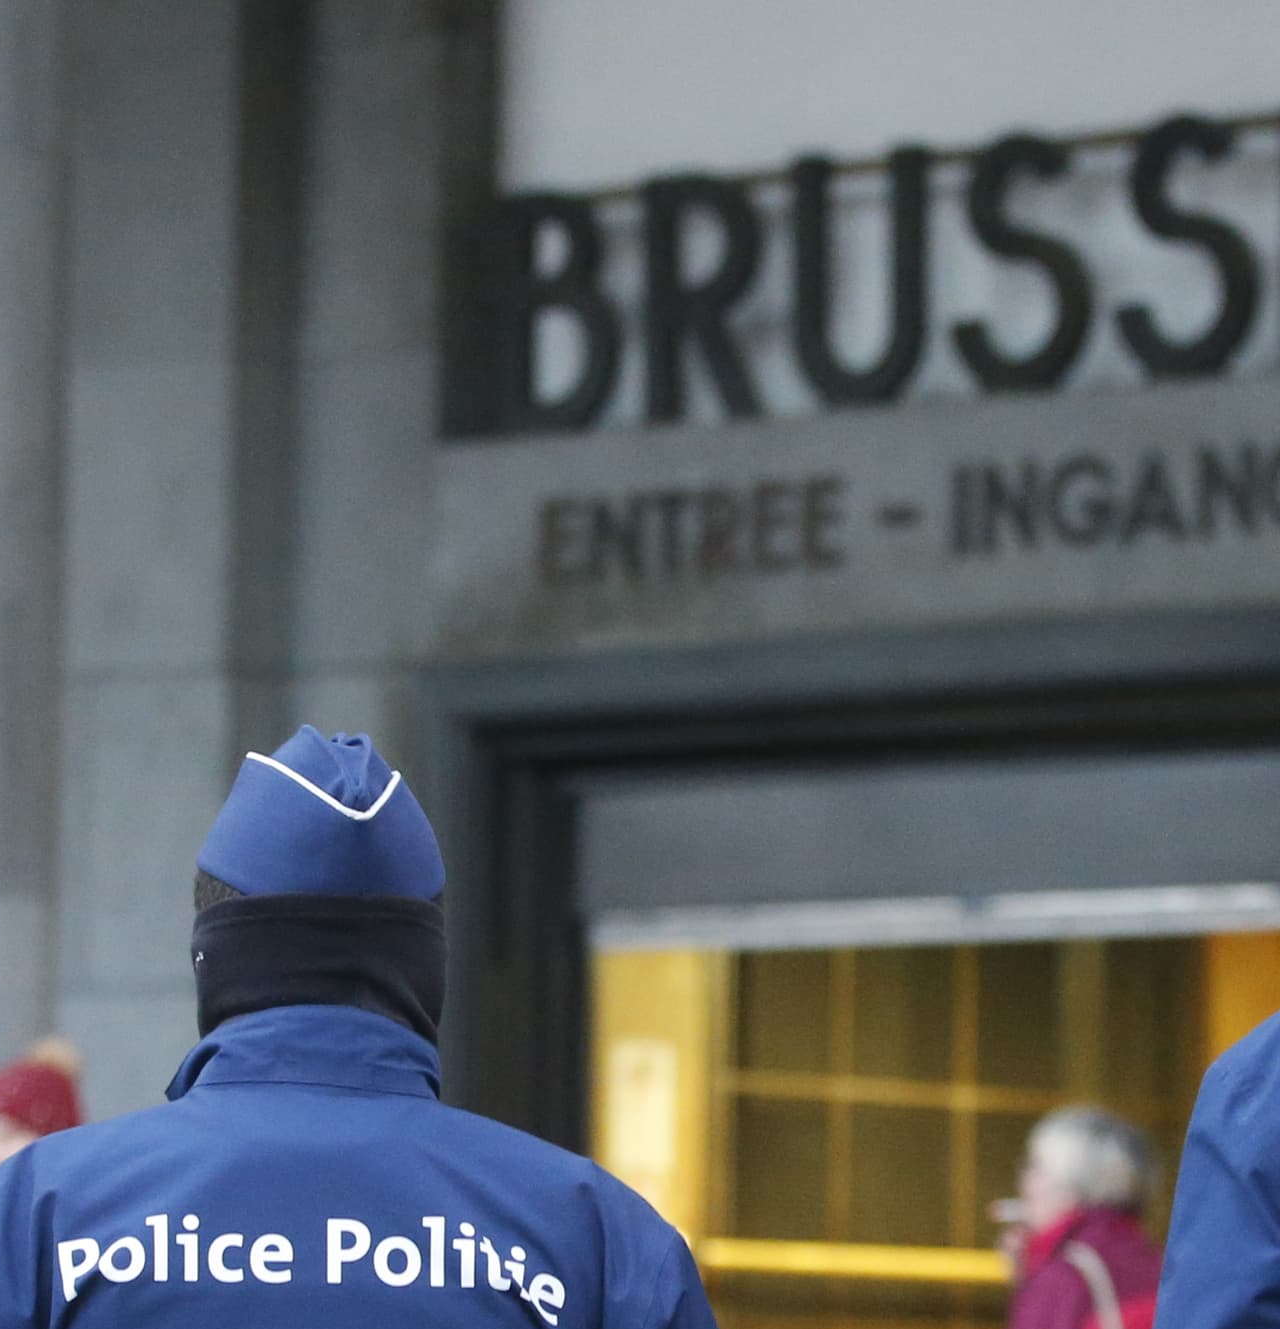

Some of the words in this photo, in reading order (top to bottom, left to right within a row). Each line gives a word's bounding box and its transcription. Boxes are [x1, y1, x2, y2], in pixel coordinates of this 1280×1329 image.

[535, 474, 847, 590] ENTREE
[58, 1213, 294, 1302] Police
[326, 1215, 566, 1327] Politie
